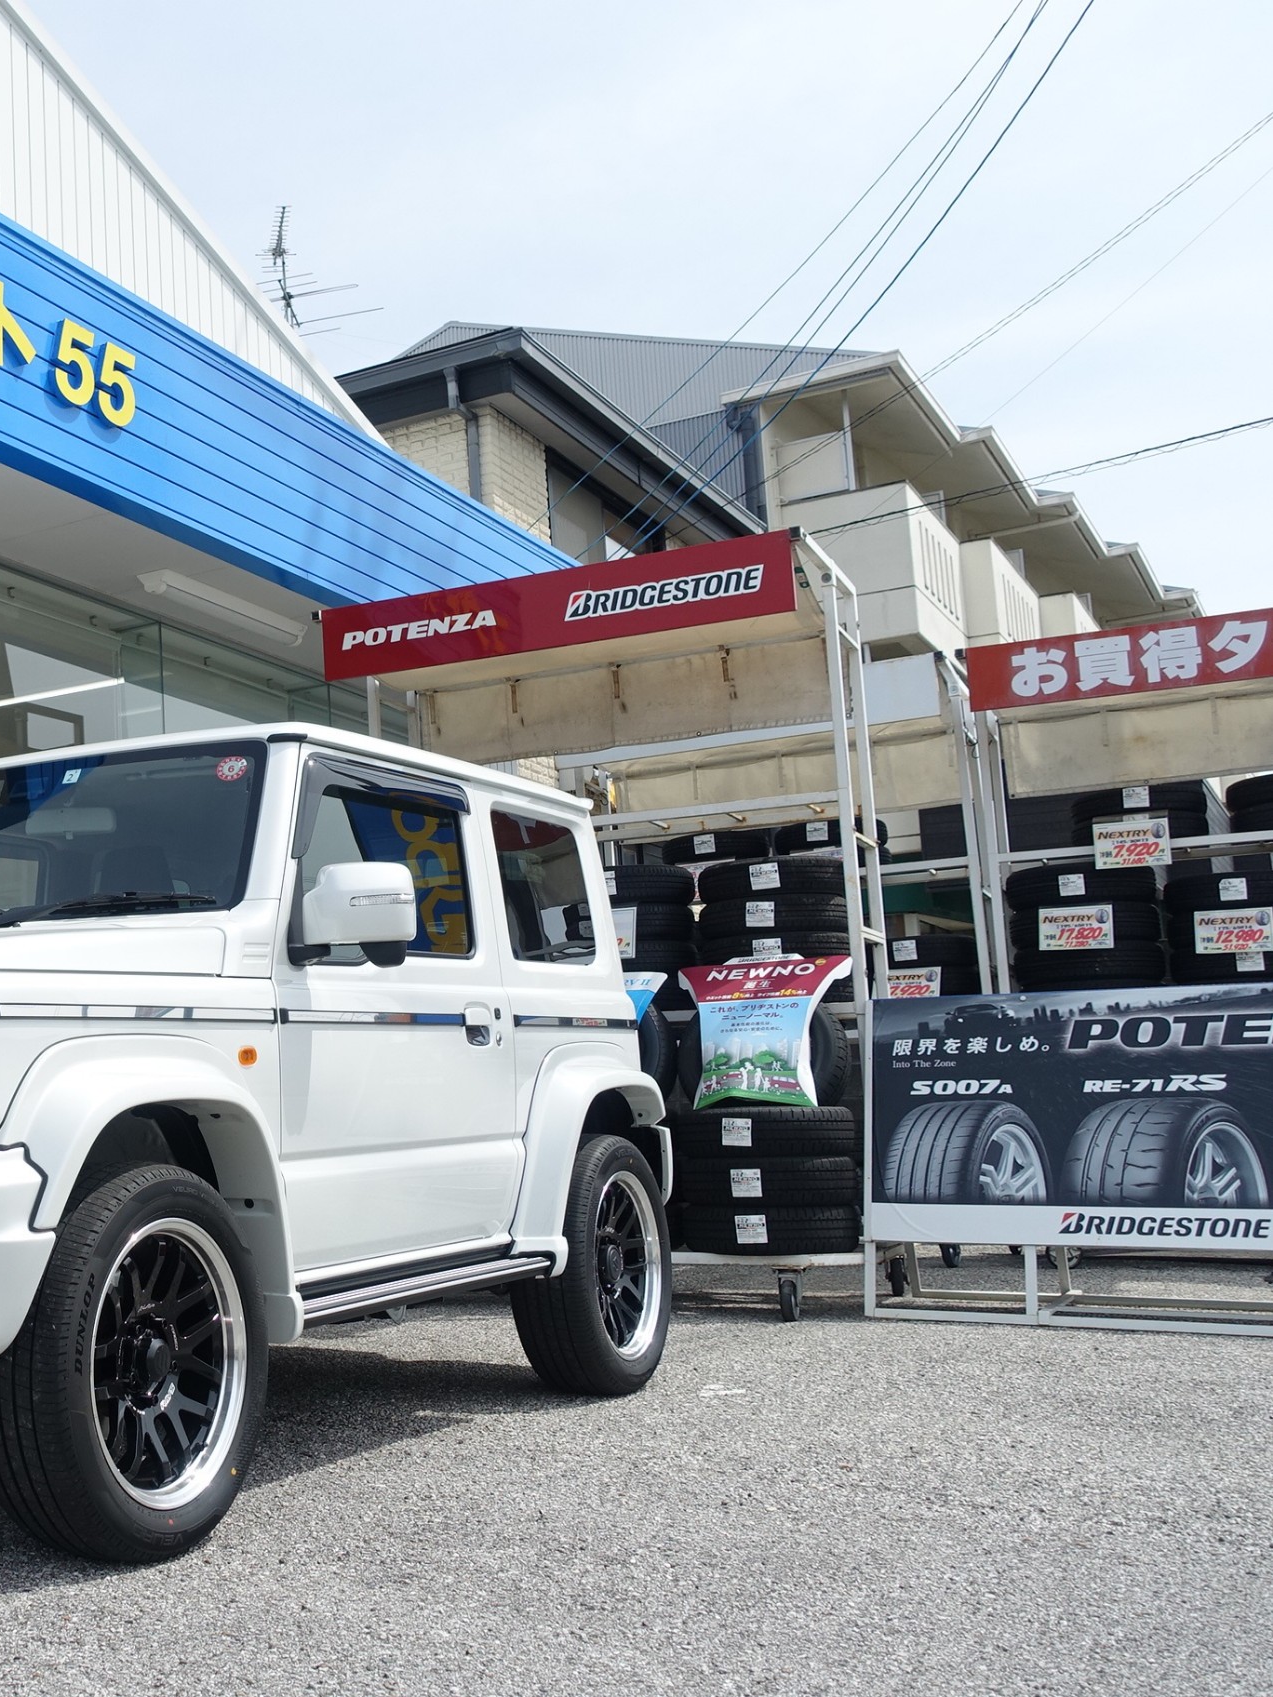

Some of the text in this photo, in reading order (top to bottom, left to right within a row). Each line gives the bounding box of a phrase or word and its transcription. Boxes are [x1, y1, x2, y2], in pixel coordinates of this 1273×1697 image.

[53, 318, 136, 428] 55
[564, 564, 764, 622] BRIDGESTONE
[342, 609, 497, 650] POTENZA
[1010, 620, 1268, 697] お買得タ
[1097, 828, 1150, 840] NEXTRY
[1042, 914, 1094, 923] NEXTRY
[1199, 916, 1254, 926] NEXTRY
[706, 963, 815, 982] NEWNO
[1068, 1012, 1273, 1050] POTE
[892, 1035, 1050, 1056] 限界を楽しめ。
[892, 1060, 956, 1068] Into The Zone
[1058, 1212, 1271, 1239] BRIDGESTONE
[74, 1272, 96, 1377] DUNLOP
